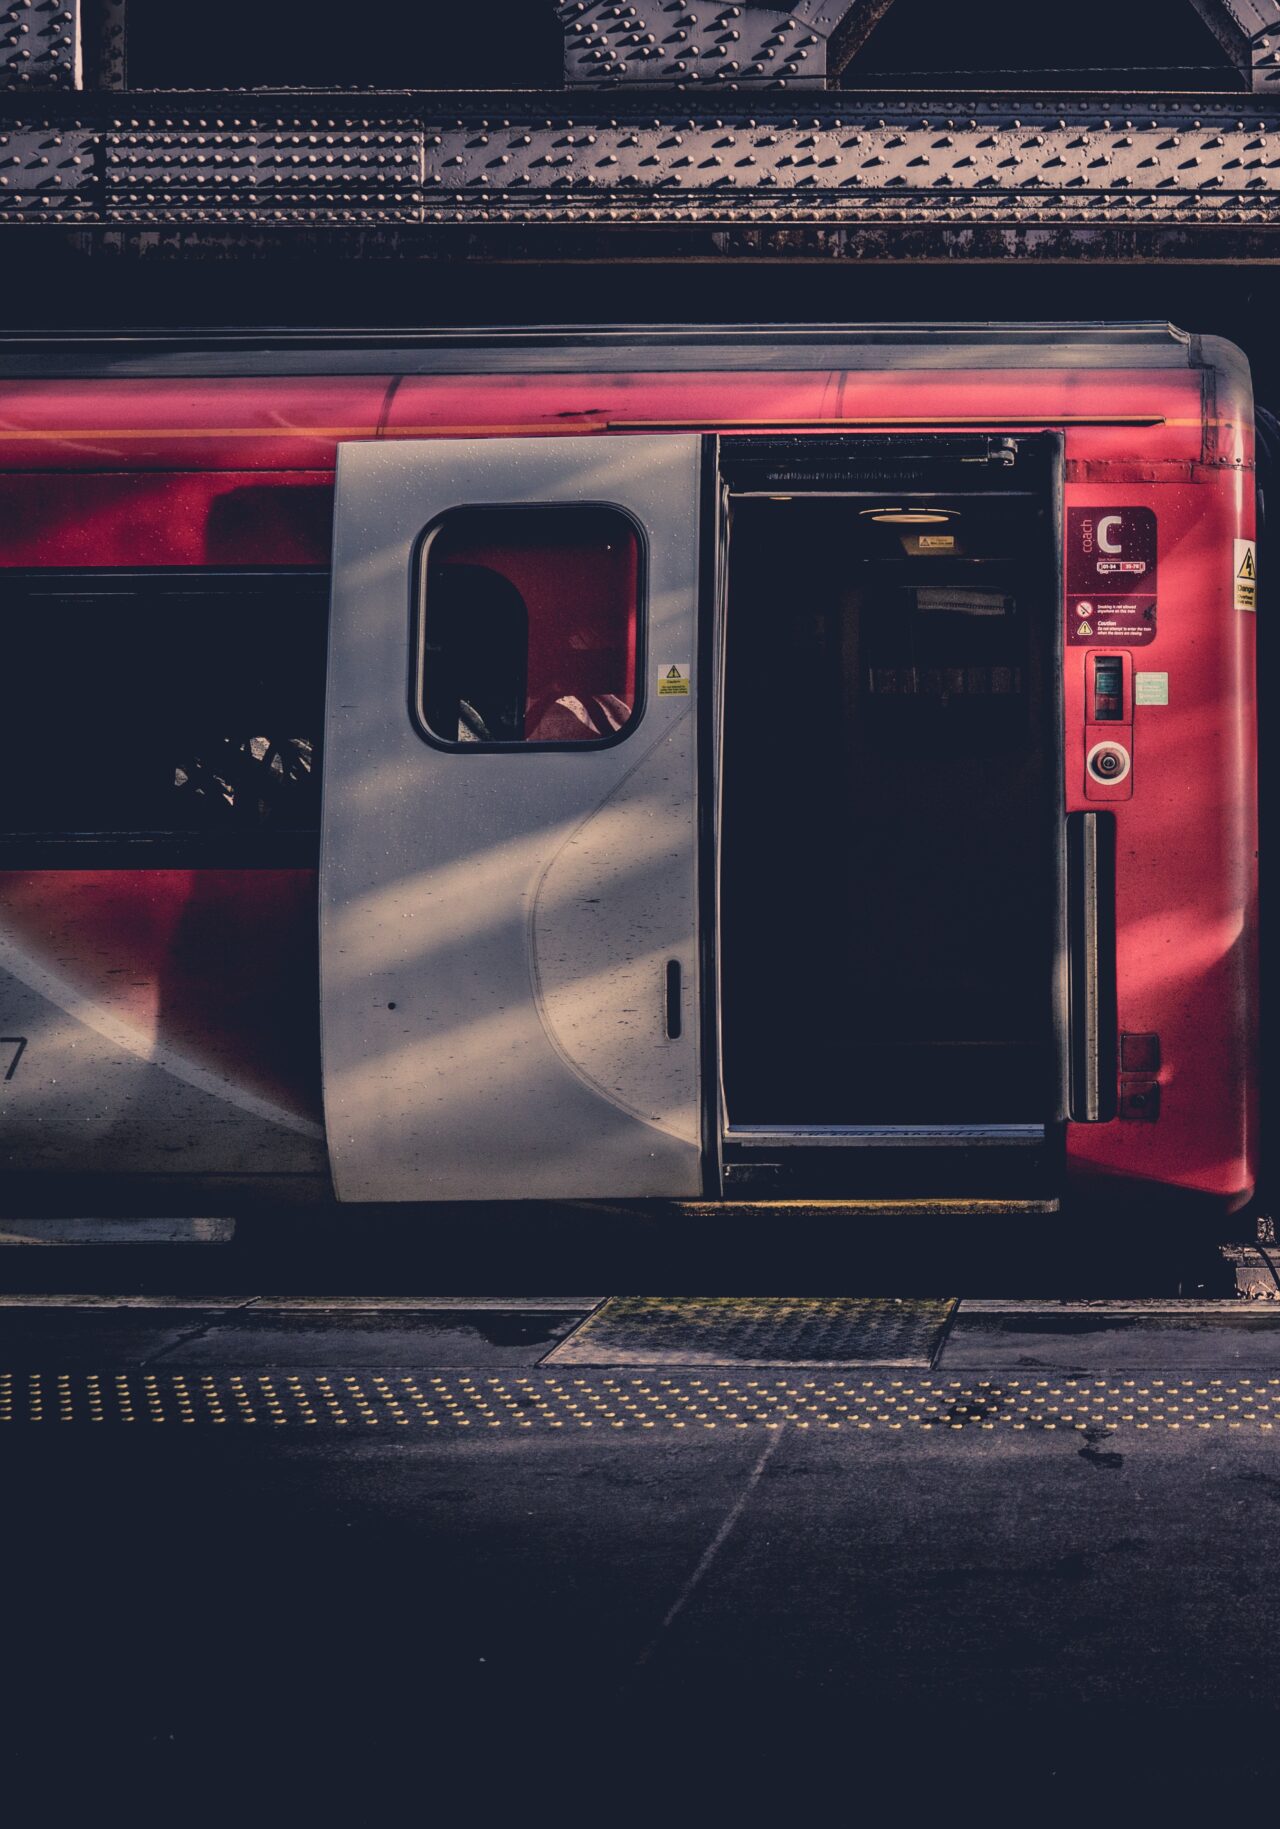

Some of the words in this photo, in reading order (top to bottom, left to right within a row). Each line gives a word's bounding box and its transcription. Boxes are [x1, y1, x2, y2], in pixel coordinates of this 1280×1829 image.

[1080, 519, 1093, 553] coach
[1097, 515, 1122, 554] C
[0, 1036, 28, 1080] 7
